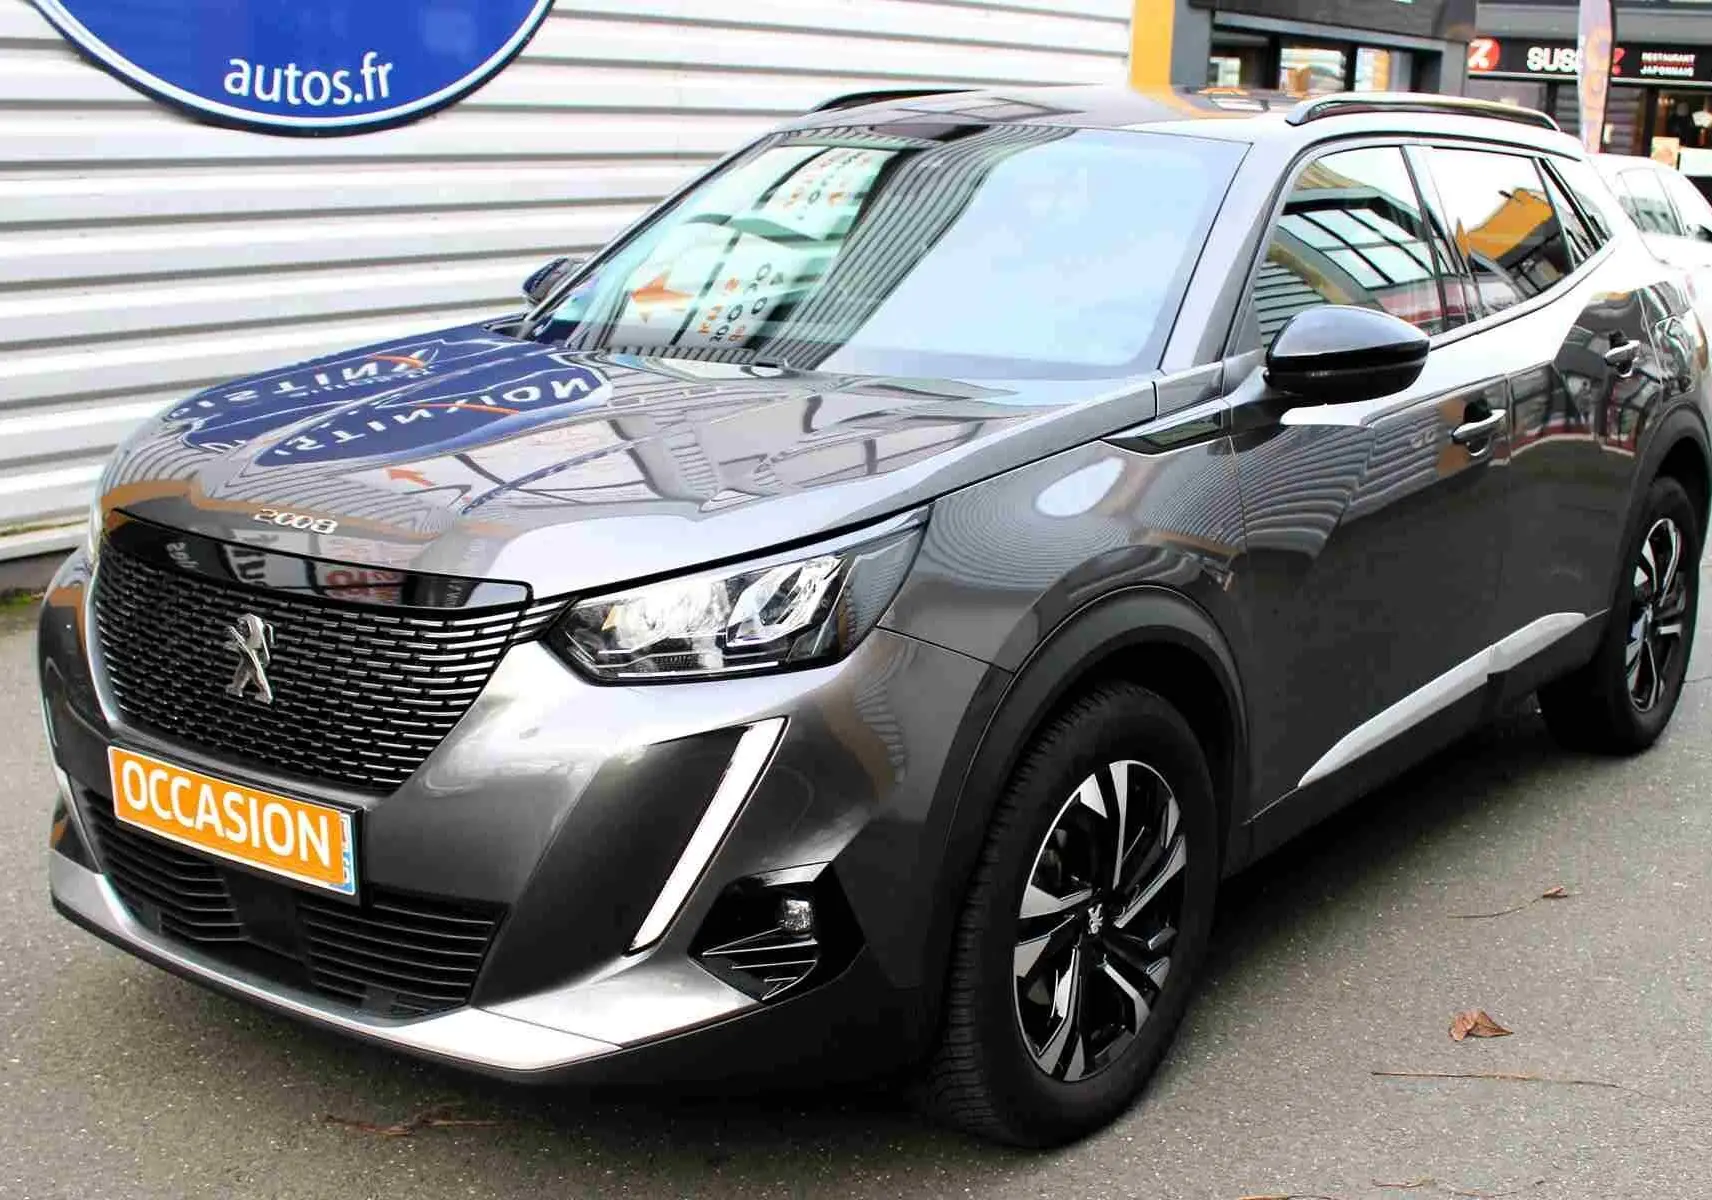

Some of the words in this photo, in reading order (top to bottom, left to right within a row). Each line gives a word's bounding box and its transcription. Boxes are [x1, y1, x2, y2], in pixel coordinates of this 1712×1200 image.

[223, 51, 393, 106] autos.fr
[253, 508, 339, 535] 2008
[122, 759, 332, 868] OCCASION
